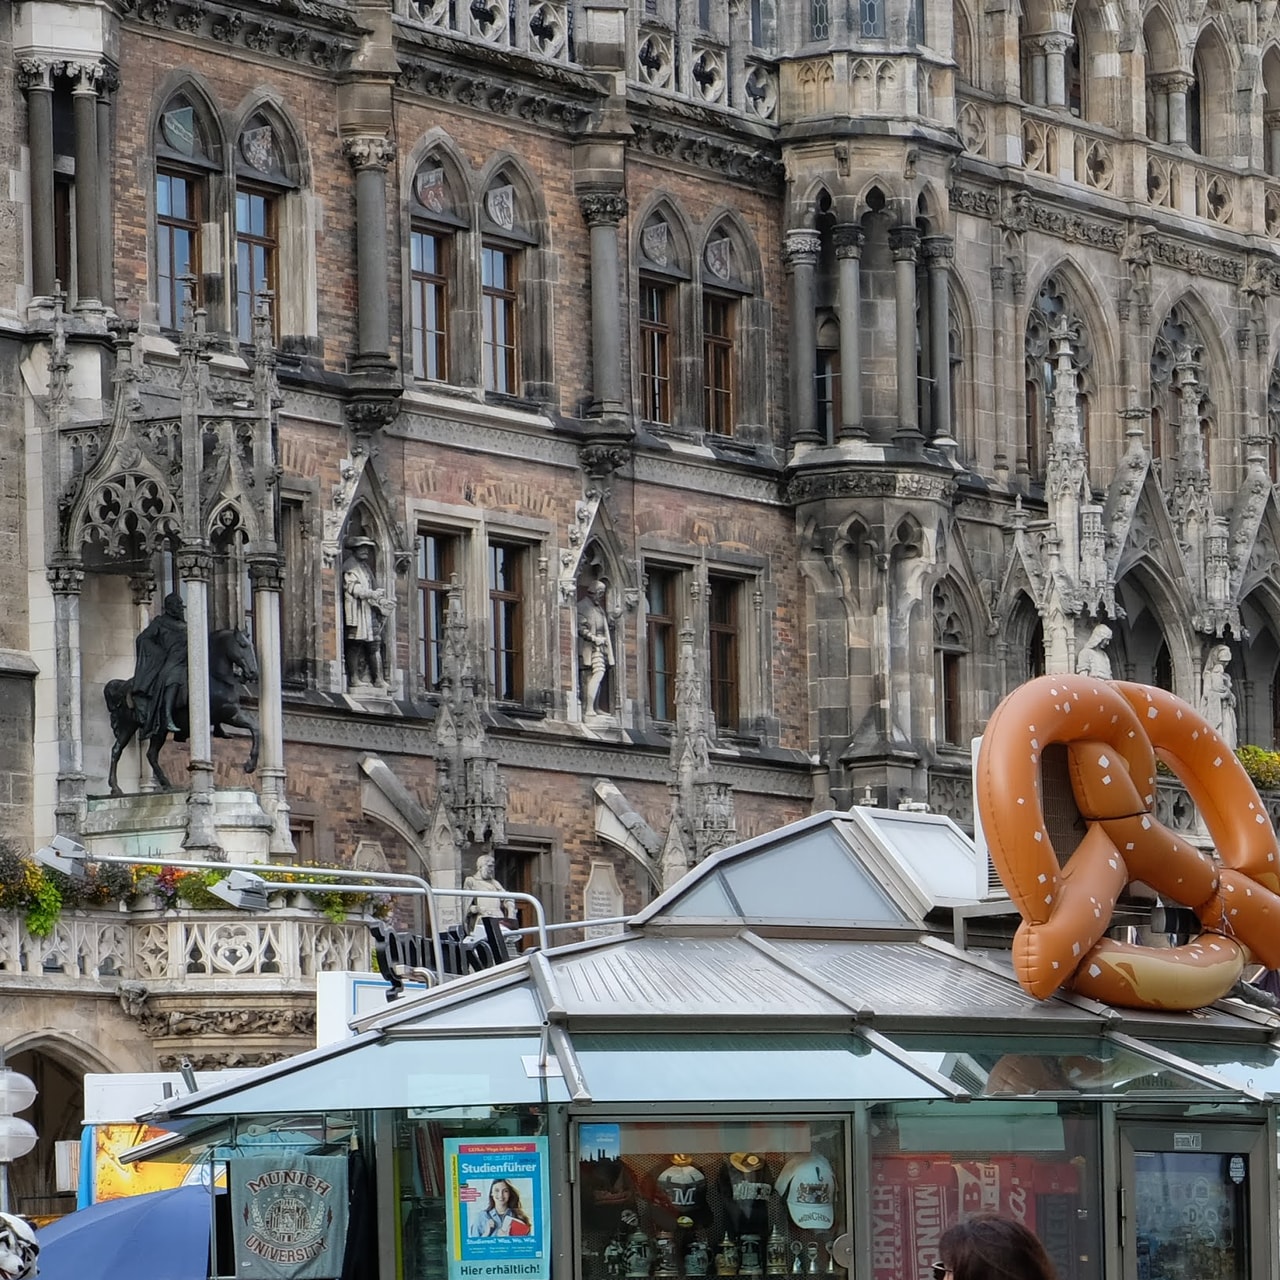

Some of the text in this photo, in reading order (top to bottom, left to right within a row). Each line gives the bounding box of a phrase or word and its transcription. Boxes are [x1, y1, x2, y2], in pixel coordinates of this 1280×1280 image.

[461, 1162, 537, 1174] Studienführer
[246, 1169, 332, 1198] MUNICH
[672, 1188, 696, 1205] M
[245, 1234, 328, 1263] UNIVERSITY
[460, 1264, 540, 1276] Hier erhältlich!
